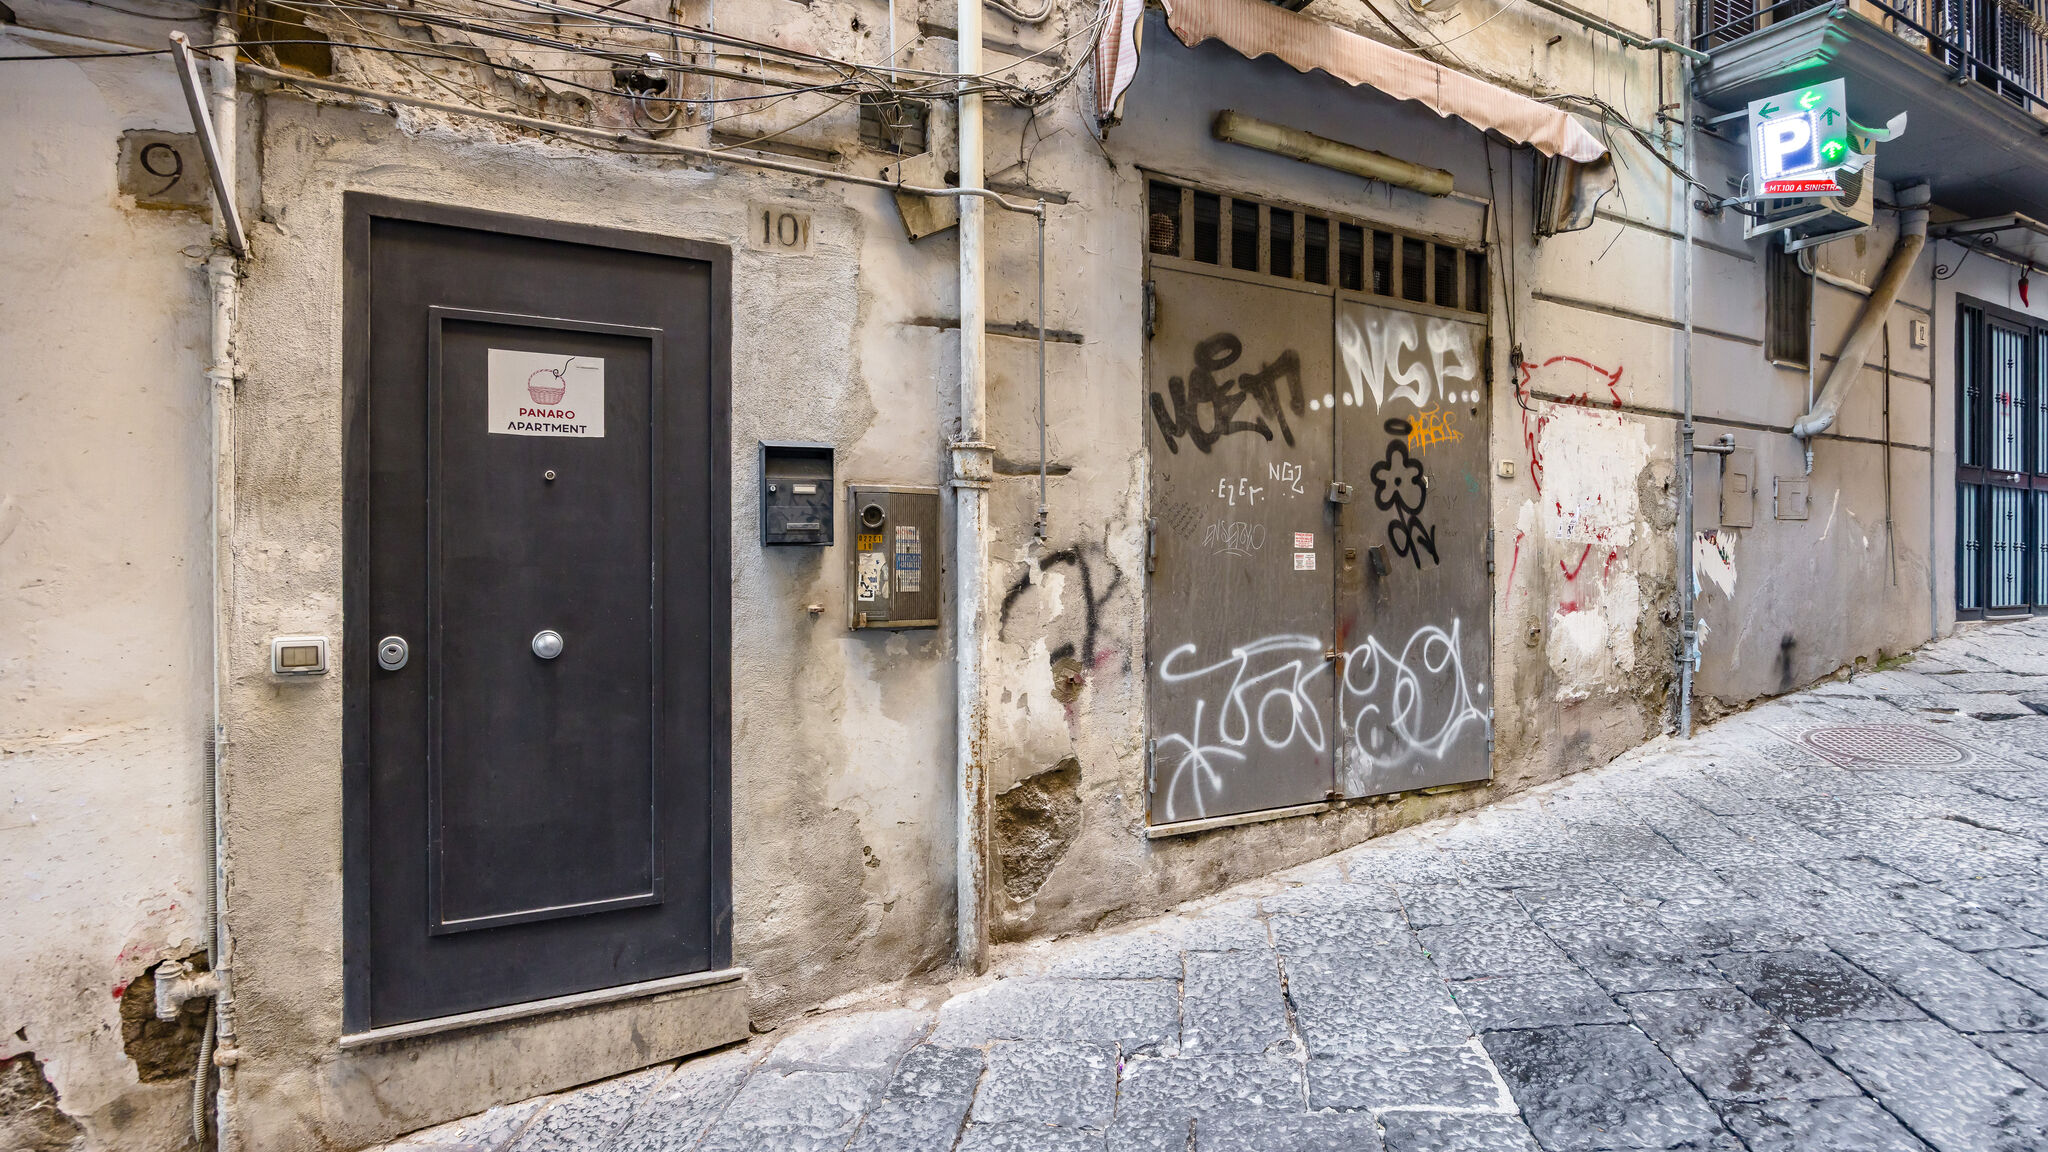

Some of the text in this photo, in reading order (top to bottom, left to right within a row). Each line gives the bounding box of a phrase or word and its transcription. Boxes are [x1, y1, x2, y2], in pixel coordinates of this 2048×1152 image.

[1763, 119, 1812, 176] P
[140, 142, 184, 197] 9
[1769, 184, 1795, 192] MT.100
[1796, 184, 1802, 192] A
[762, 210, 799, 247] 10
[519, 407, 576, 420] PANARO
[507, 421, 588, 434] APARTMENT
